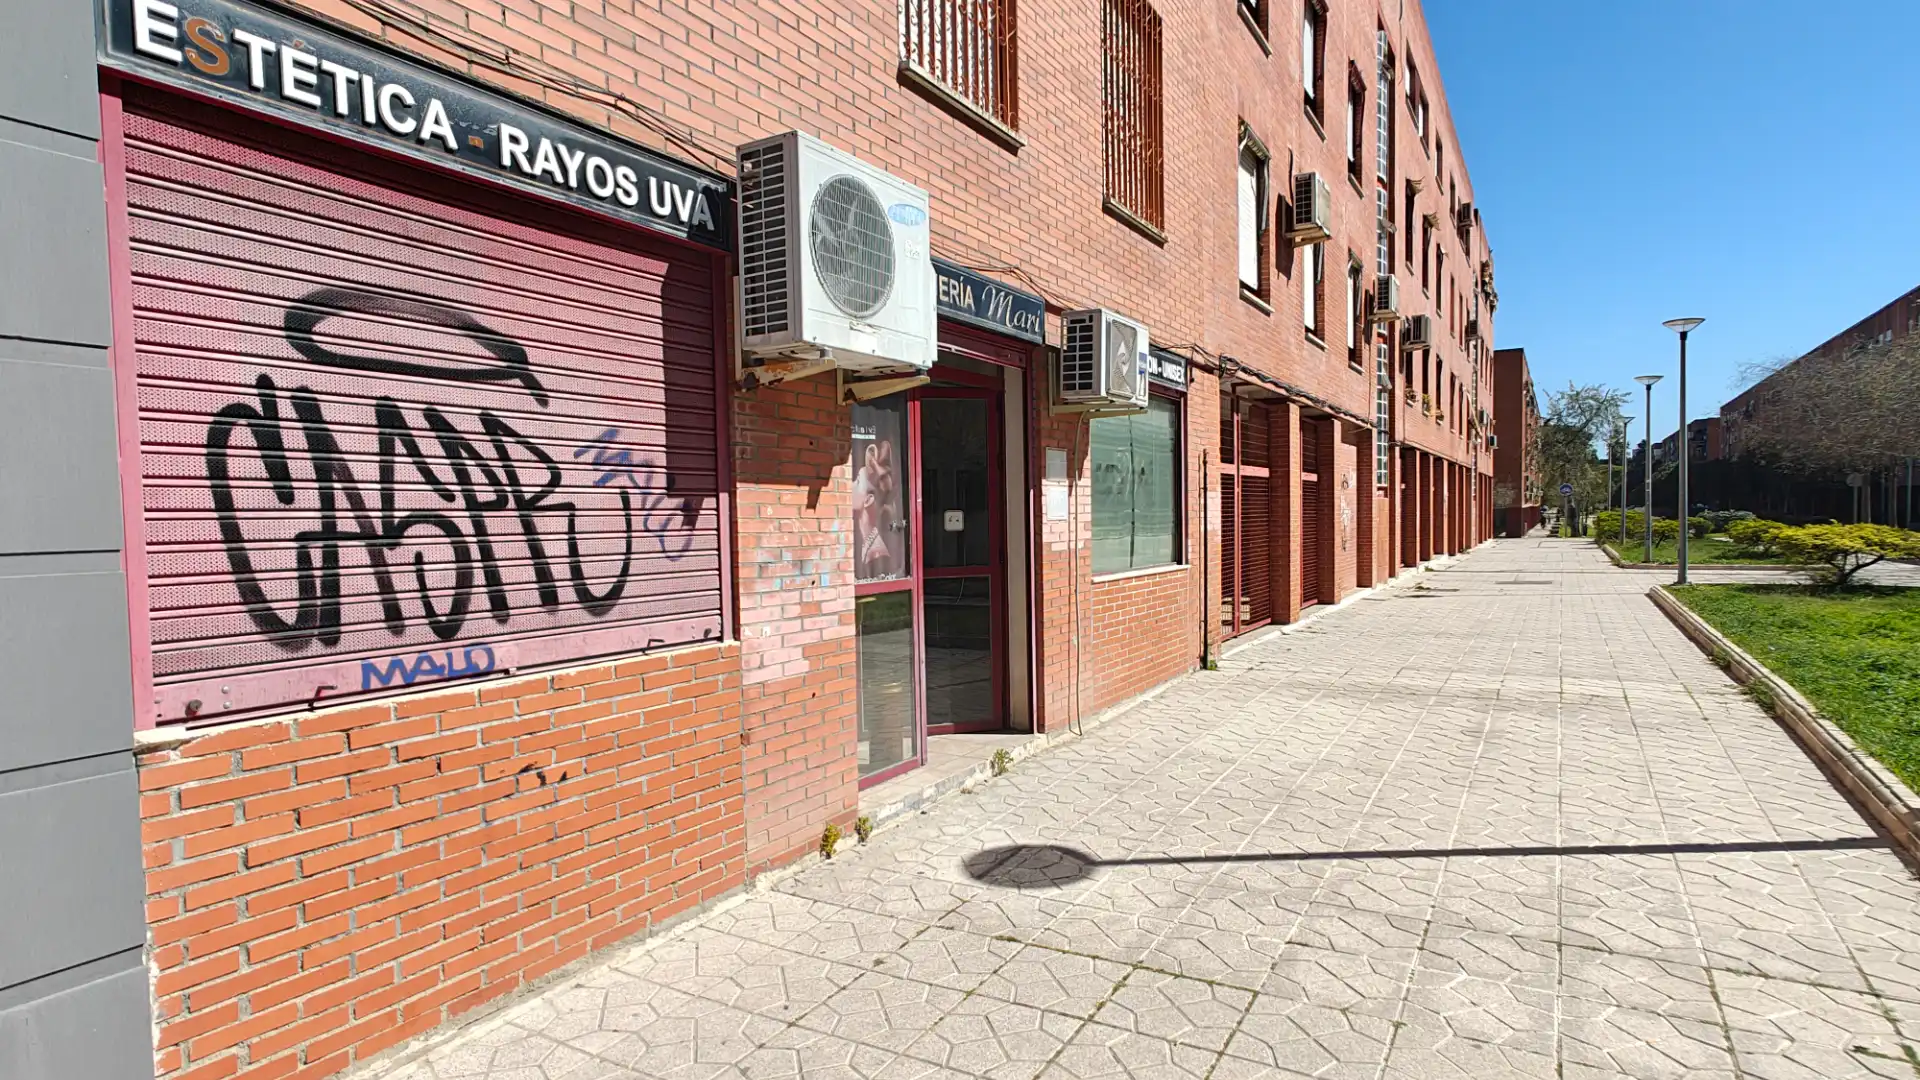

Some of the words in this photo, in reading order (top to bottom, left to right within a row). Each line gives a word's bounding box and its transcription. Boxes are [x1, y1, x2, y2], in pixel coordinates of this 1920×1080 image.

[133, 0, 459, 151] ESTÉTICA
[499, 122, 639, 207] RAYOS
[648, 175, 715, 232] UVA
[981, 284, 1041, 333] Mari
